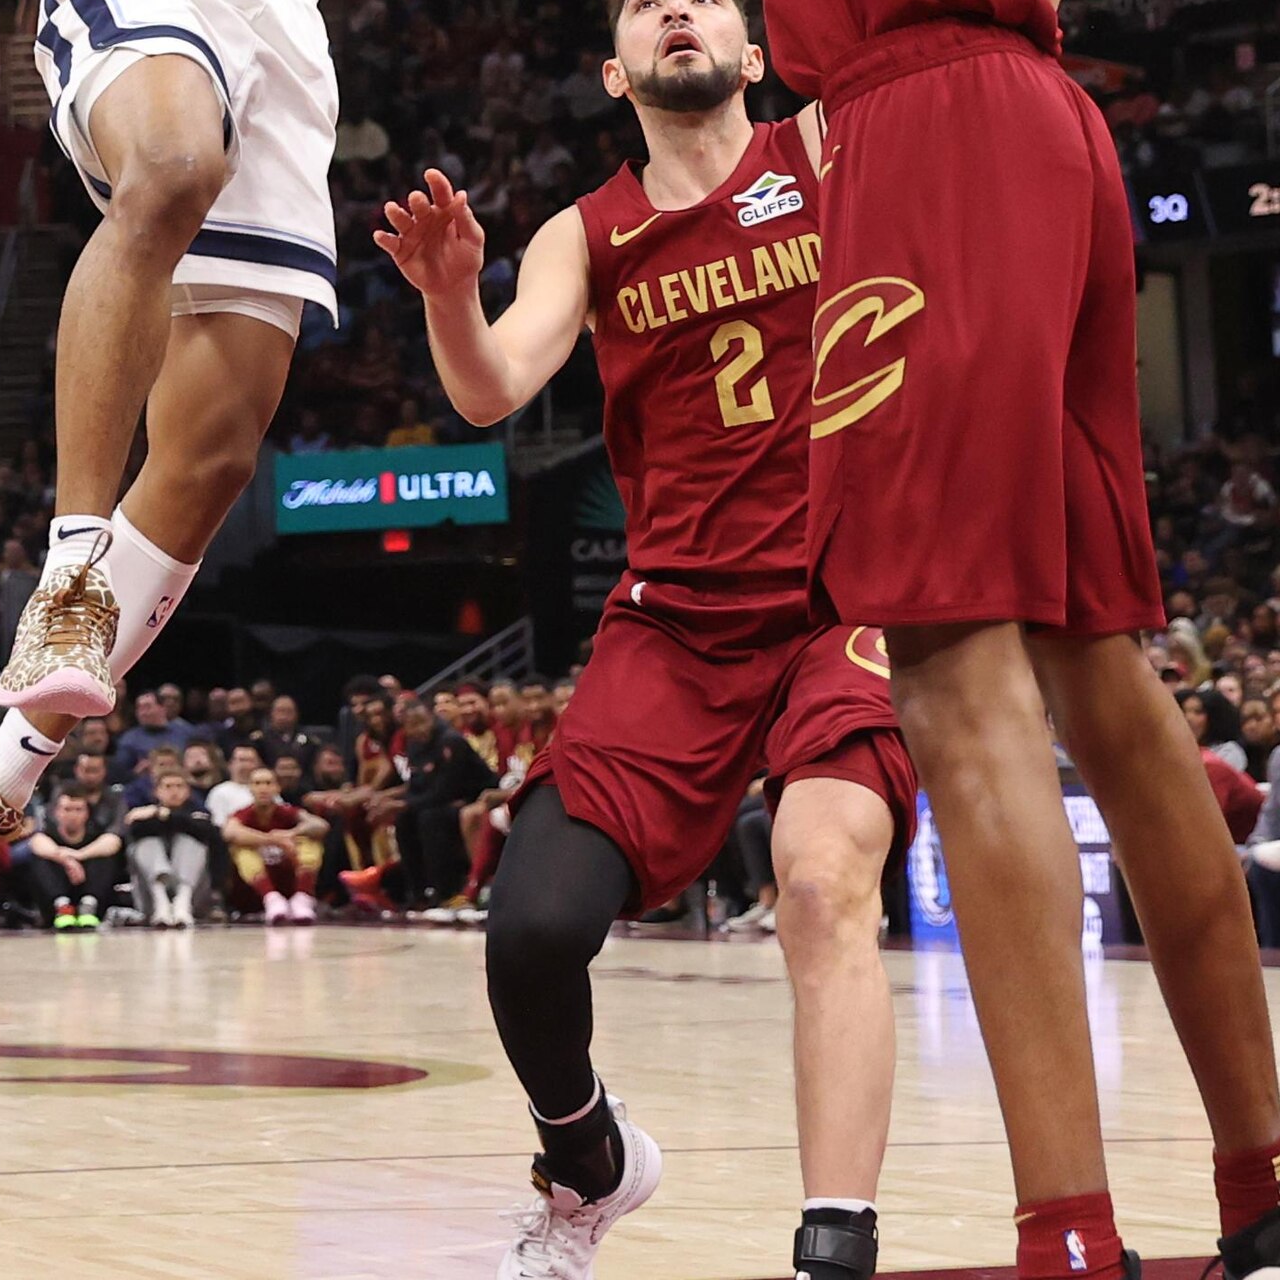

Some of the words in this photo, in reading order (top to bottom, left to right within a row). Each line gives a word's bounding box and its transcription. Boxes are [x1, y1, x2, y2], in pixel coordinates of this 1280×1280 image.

[741, 193, 802, 224] CLIFFS
[617, 232, 821, 334] CLEVELAND
[709, 319, 775, 428] 2
[398, 470, 496, 501] ULTRA
